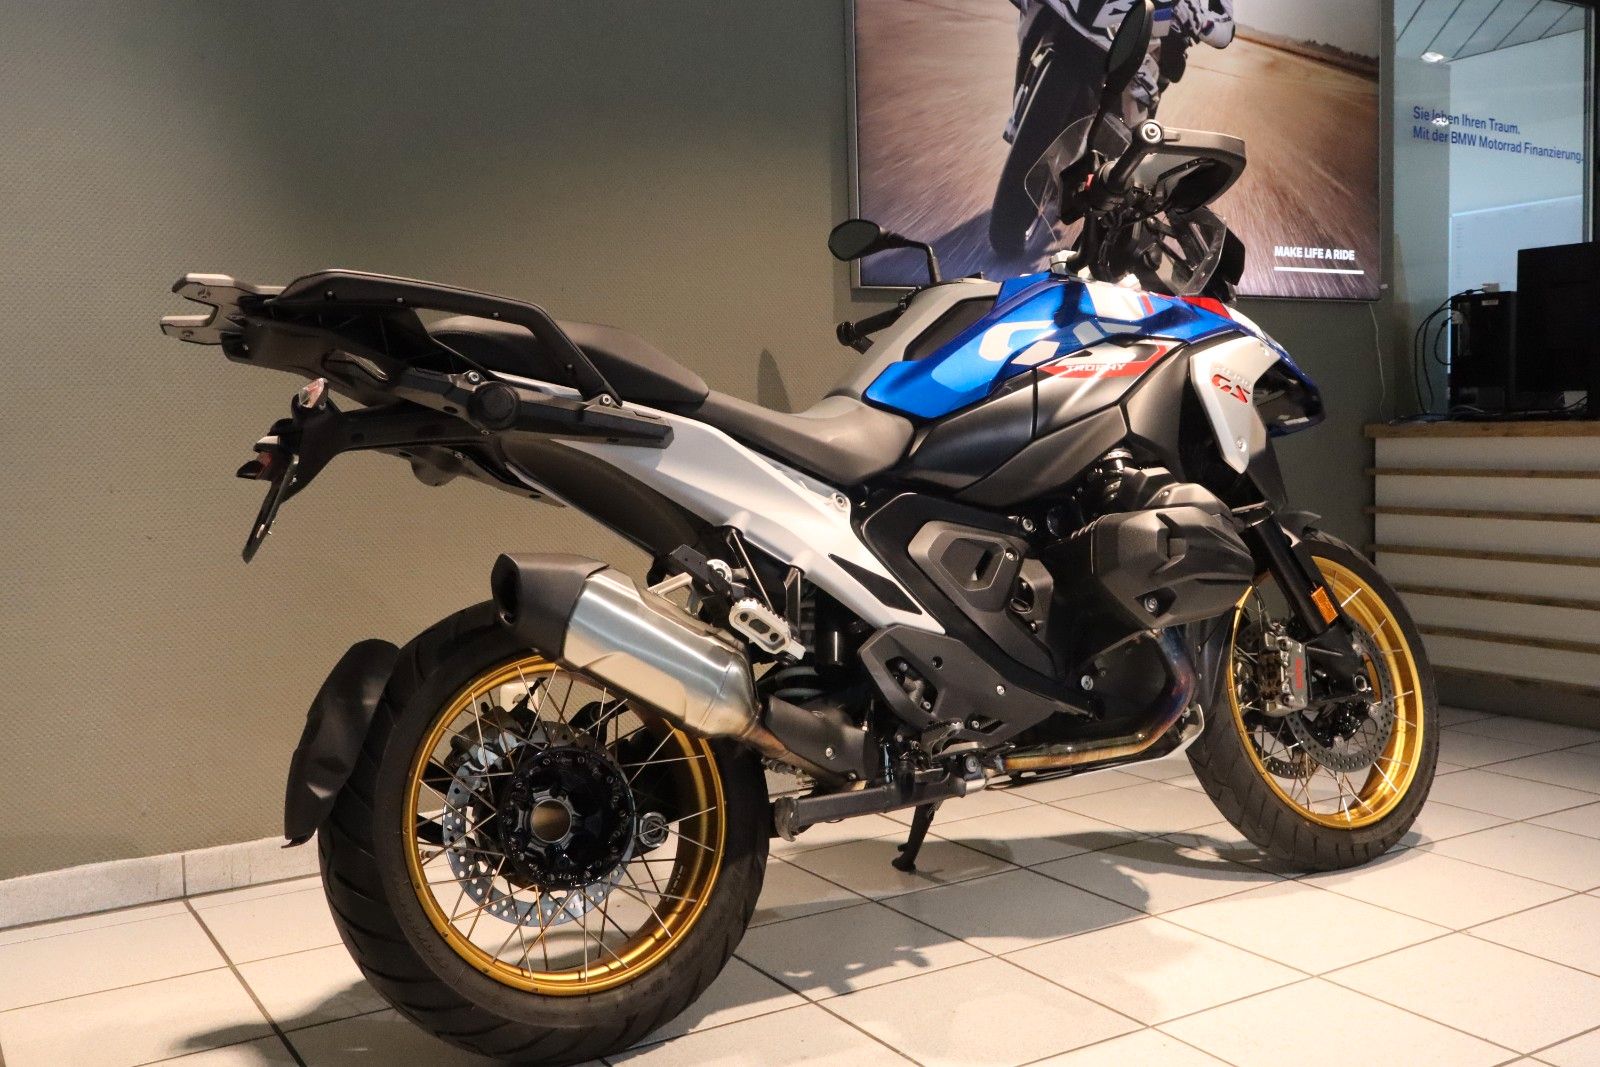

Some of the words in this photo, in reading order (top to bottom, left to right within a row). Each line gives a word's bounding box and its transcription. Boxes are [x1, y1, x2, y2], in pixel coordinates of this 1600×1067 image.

[1413, 105, 1430, 121] Sie
[1432, 109, 1460, 125] leben
[1462, 114, 1487, 129] Ihren
[1489, 117, 1521, 135] Traum.
[1413, 126, 1430, 140] Mit
[1432, 129, 1449, 142] der
[1451, 131, 1477, 147] BMW
[1479, 135, 1522, 154] Motorrad
[1274, 246, 1303, 258] MAKE
[1304, 247, 1324, 259] LIFE
[1325, 248, 1332, 260] A
[1333, 249, 1355, 260] RIDE
[1211, 373, 1251, 404] GS
